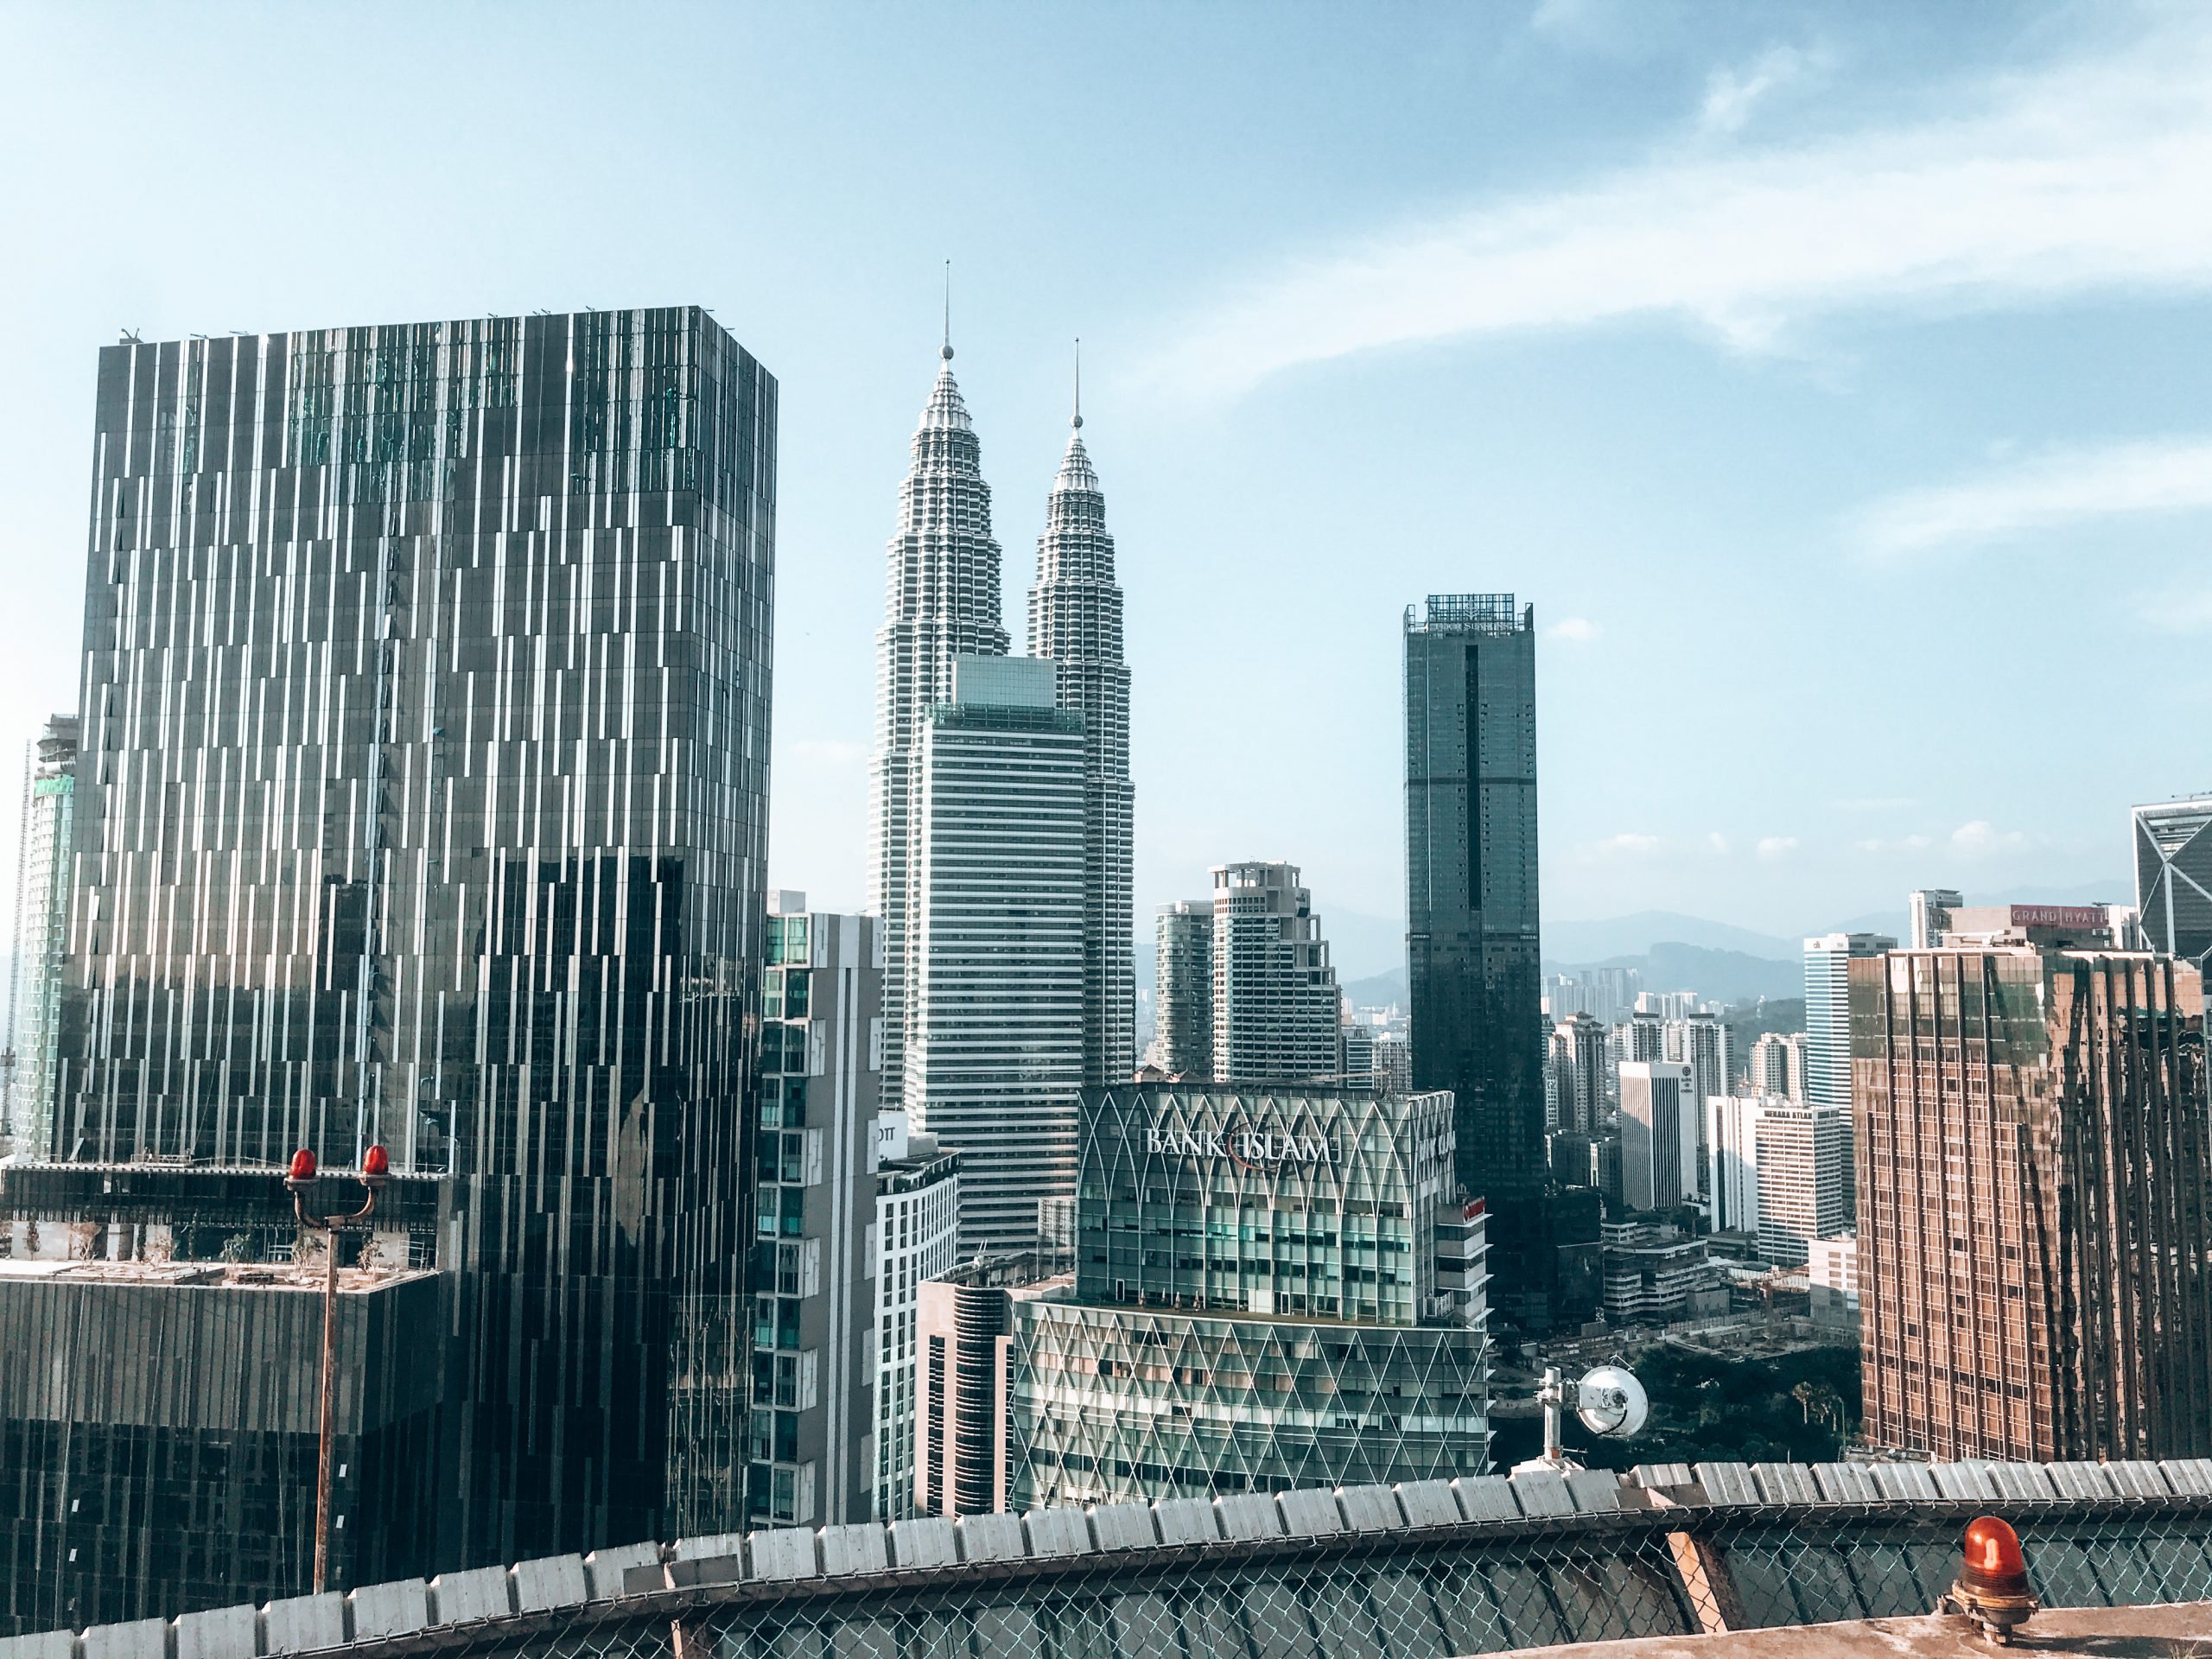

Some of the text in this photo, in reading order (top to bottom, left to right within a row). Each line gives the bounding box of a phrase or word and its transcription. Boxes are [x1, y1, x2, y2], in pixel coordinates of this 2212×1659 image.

[2012, 910, 2105, 923] GRAND HYATT
[1147, 1128, 1332, 1163] BANK ISLAM
